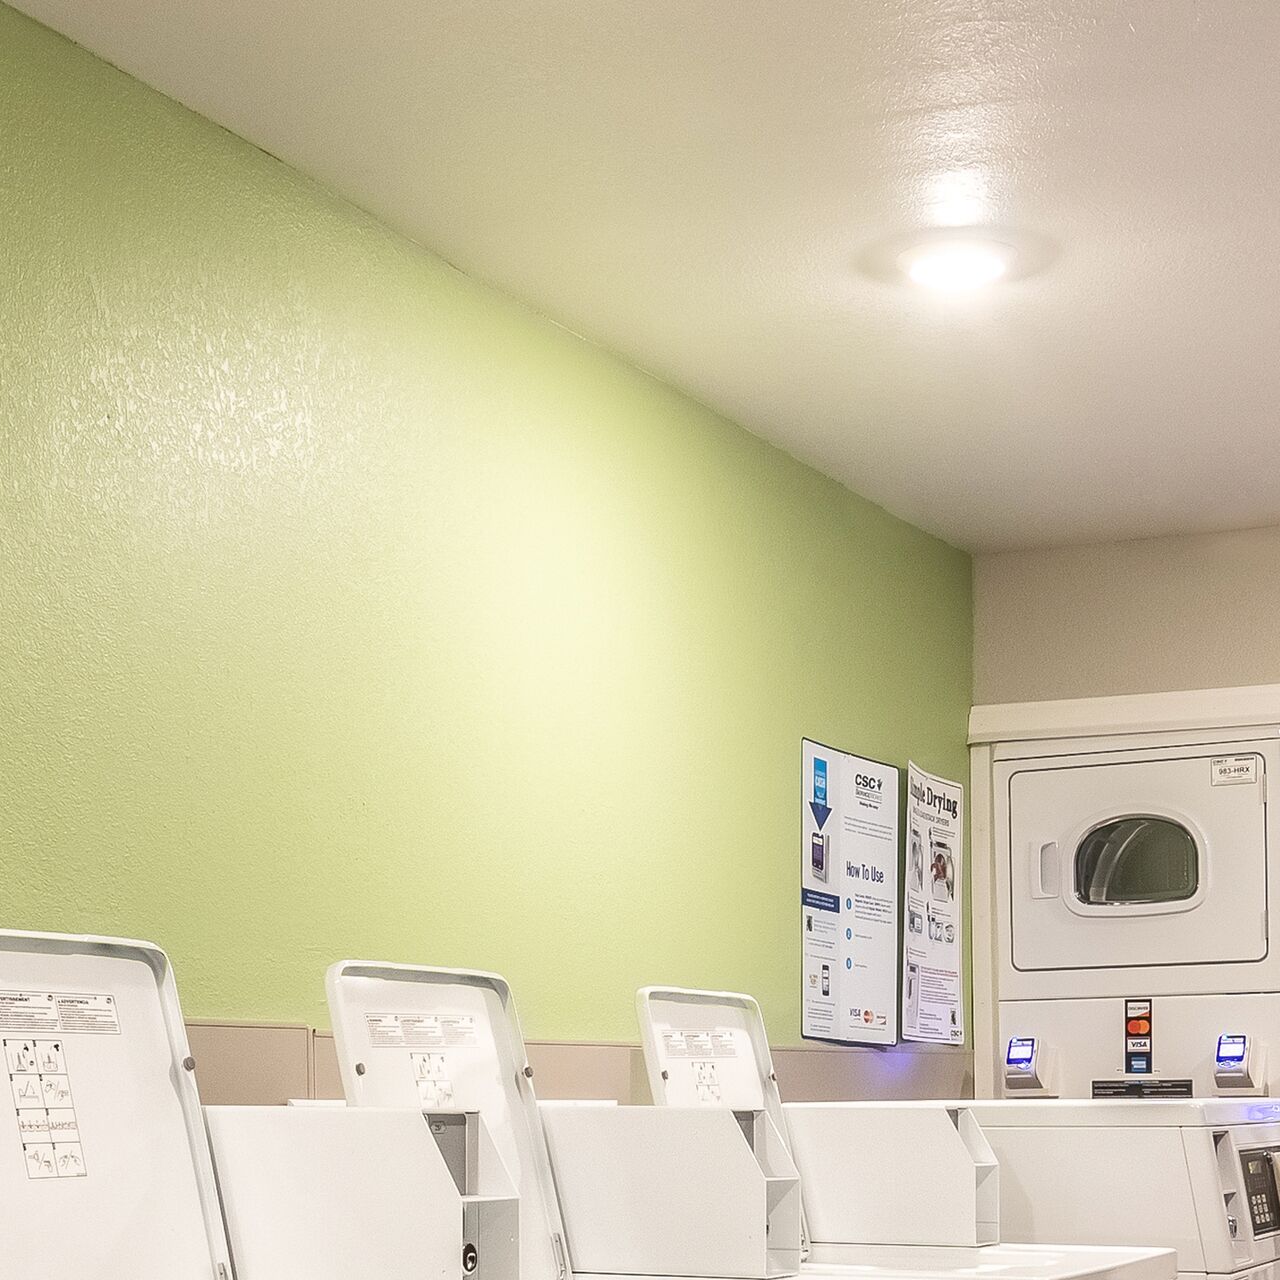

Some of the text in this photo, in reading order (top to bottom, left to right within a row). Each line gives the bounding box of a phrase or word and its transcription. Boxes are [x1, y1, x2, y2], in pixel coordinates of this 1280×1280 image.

[1218, 766, 1250, 775] 983-HRX
[854, 773, 876, 789] CSC
[926, 786, 958, 819] Drying
[846, 860, 884, 883] How To Use
[849, 1008, 861, 1017] VISA
